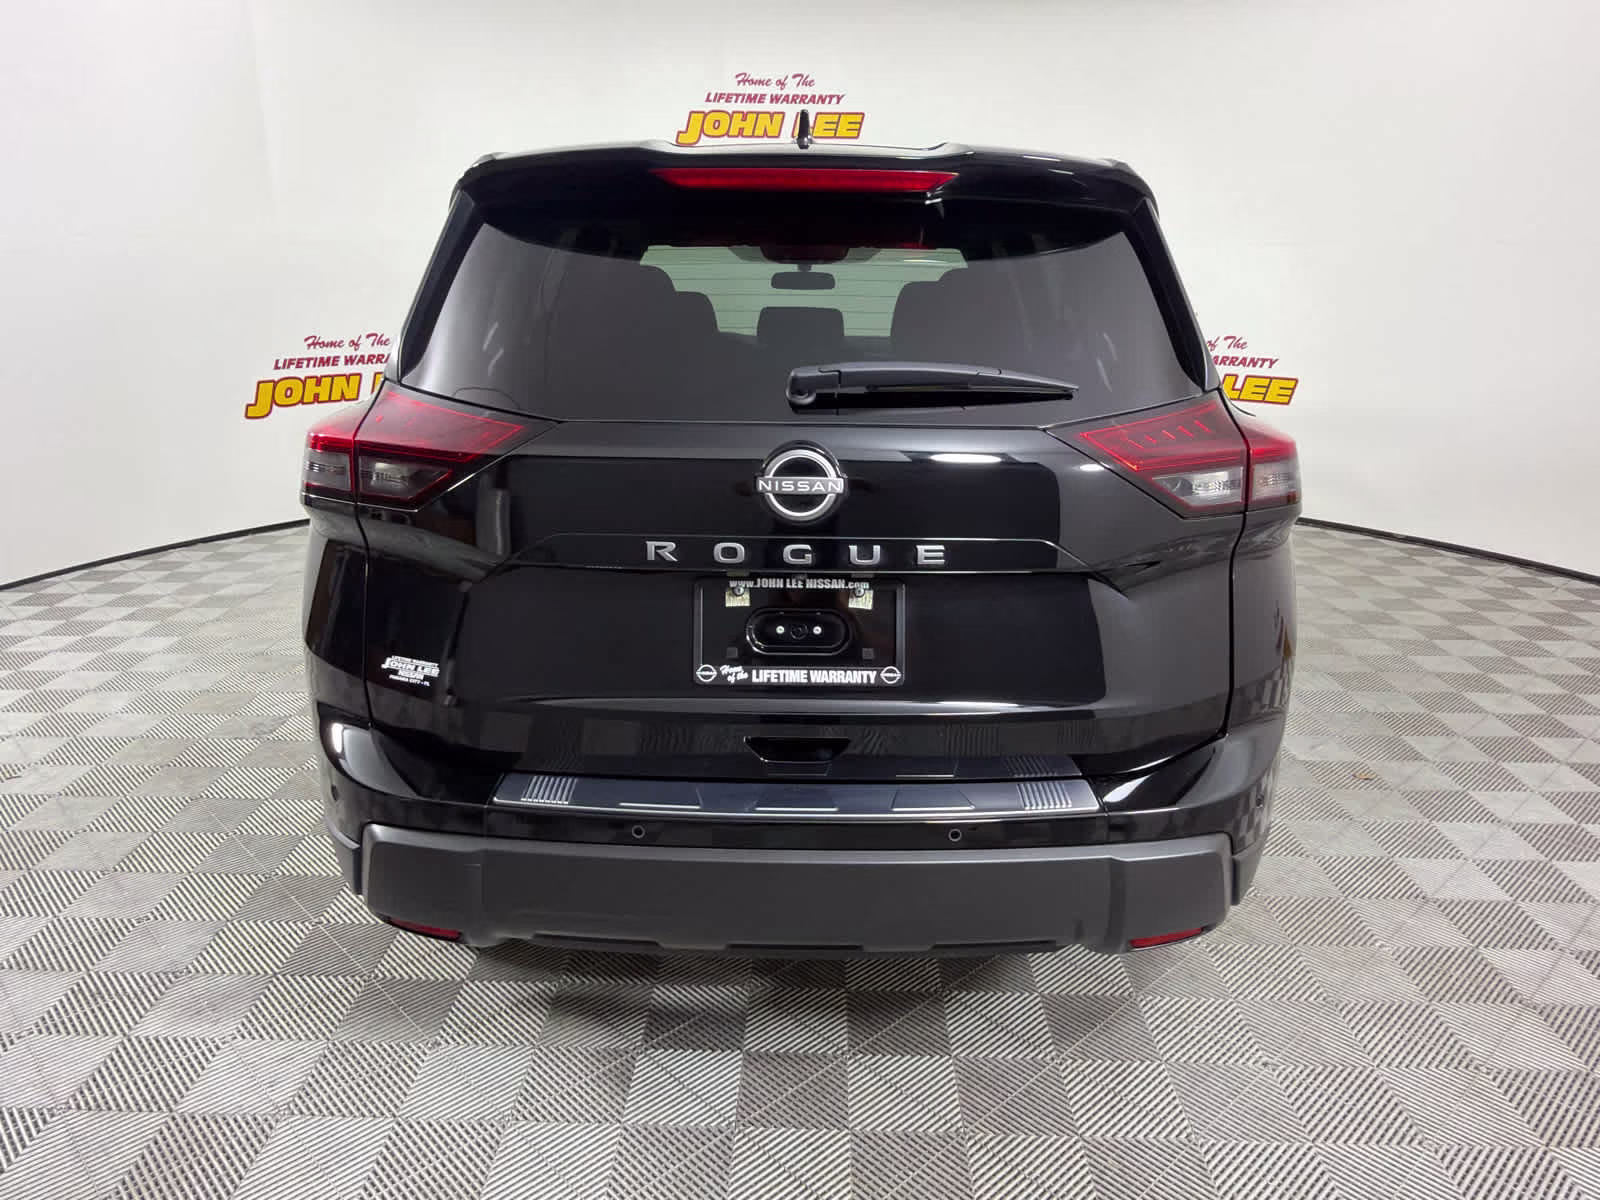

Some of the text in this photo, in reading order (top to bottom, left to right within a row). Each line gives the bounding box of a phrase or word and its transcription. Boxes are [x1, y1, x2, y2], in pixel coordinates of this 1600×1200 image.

[734, 72, 815, 90] Home of The
[705, 92, 845, 105] LIFETIME WARRANTY
[676, 110, 785, 146] JOHN
[304, 333, 390, 351] Home of The
[1224, 336, 1248, 350] The
[273, 353, 391, 370] LIFETIME WARR
[1212, 355, 1280, 368] ARRANTY
[245, 373, 362, 419] JOHN
[1222, 374, 1299, 405] LEE
[758, 478, 843, 493] NISSAN
[646, 541, 945, 565] ROGUE
[786, 578, 803, 588] LEE
[752, 669, 877, 684] LIFETIME WARRANTY
